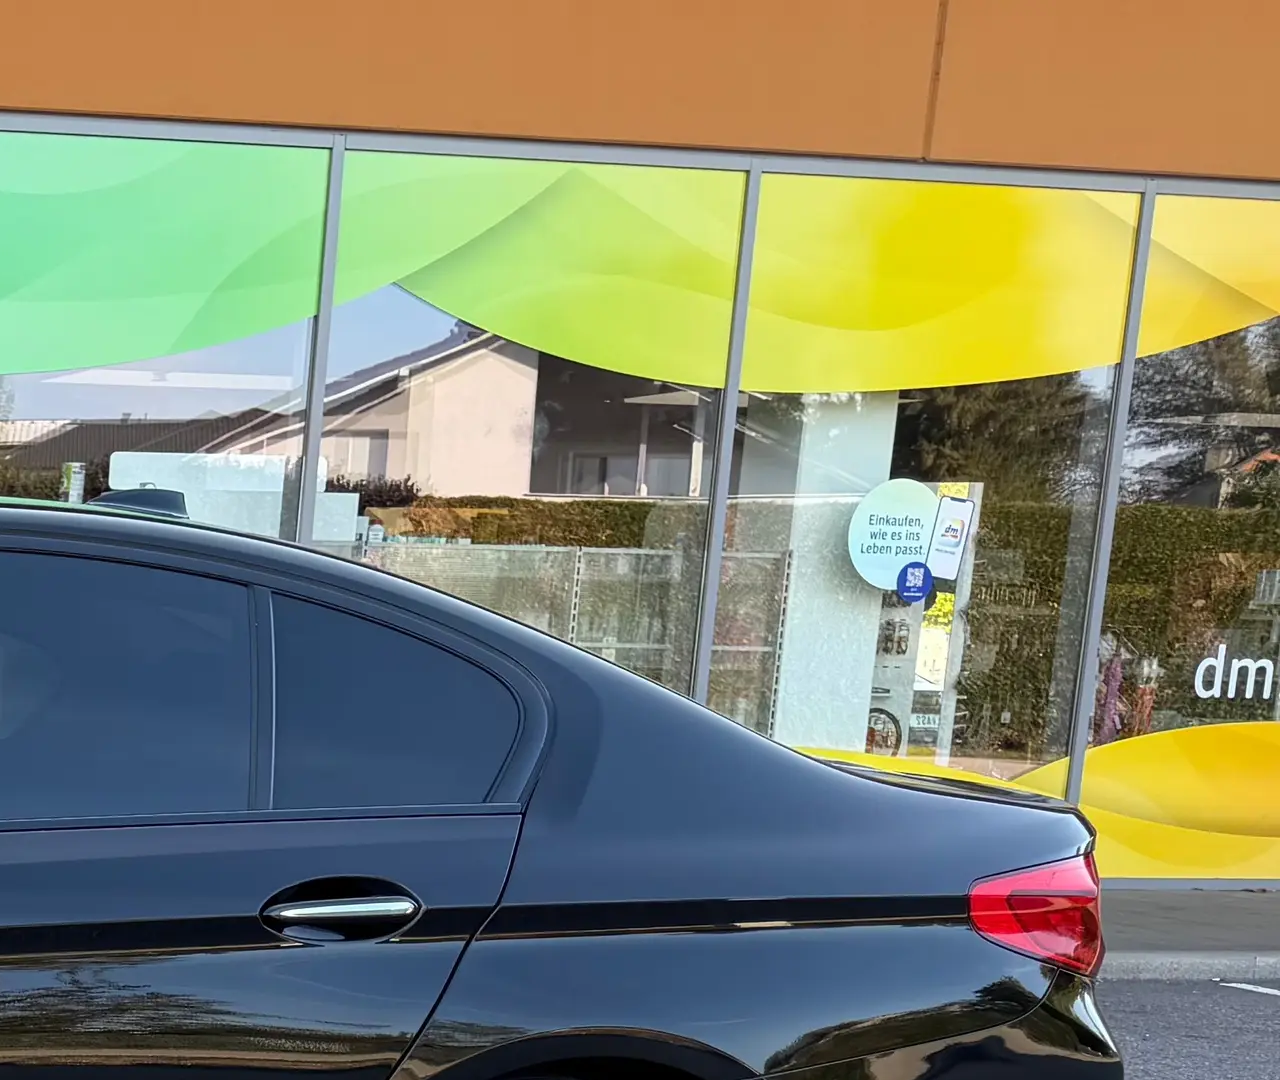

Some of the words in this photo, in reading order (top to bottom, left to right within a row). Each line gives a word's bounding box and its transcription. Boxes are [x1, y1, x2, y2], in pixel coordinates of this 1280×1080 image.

[868, 514, 924, 529] Einkaufen,
[870, 529, 888, 541] wie
[890, 532, 902, 541] es
[905, 530, 921, 541] ins
[860, 543, 892, 555] Leben
[895, 544, 926, 557] passt.
